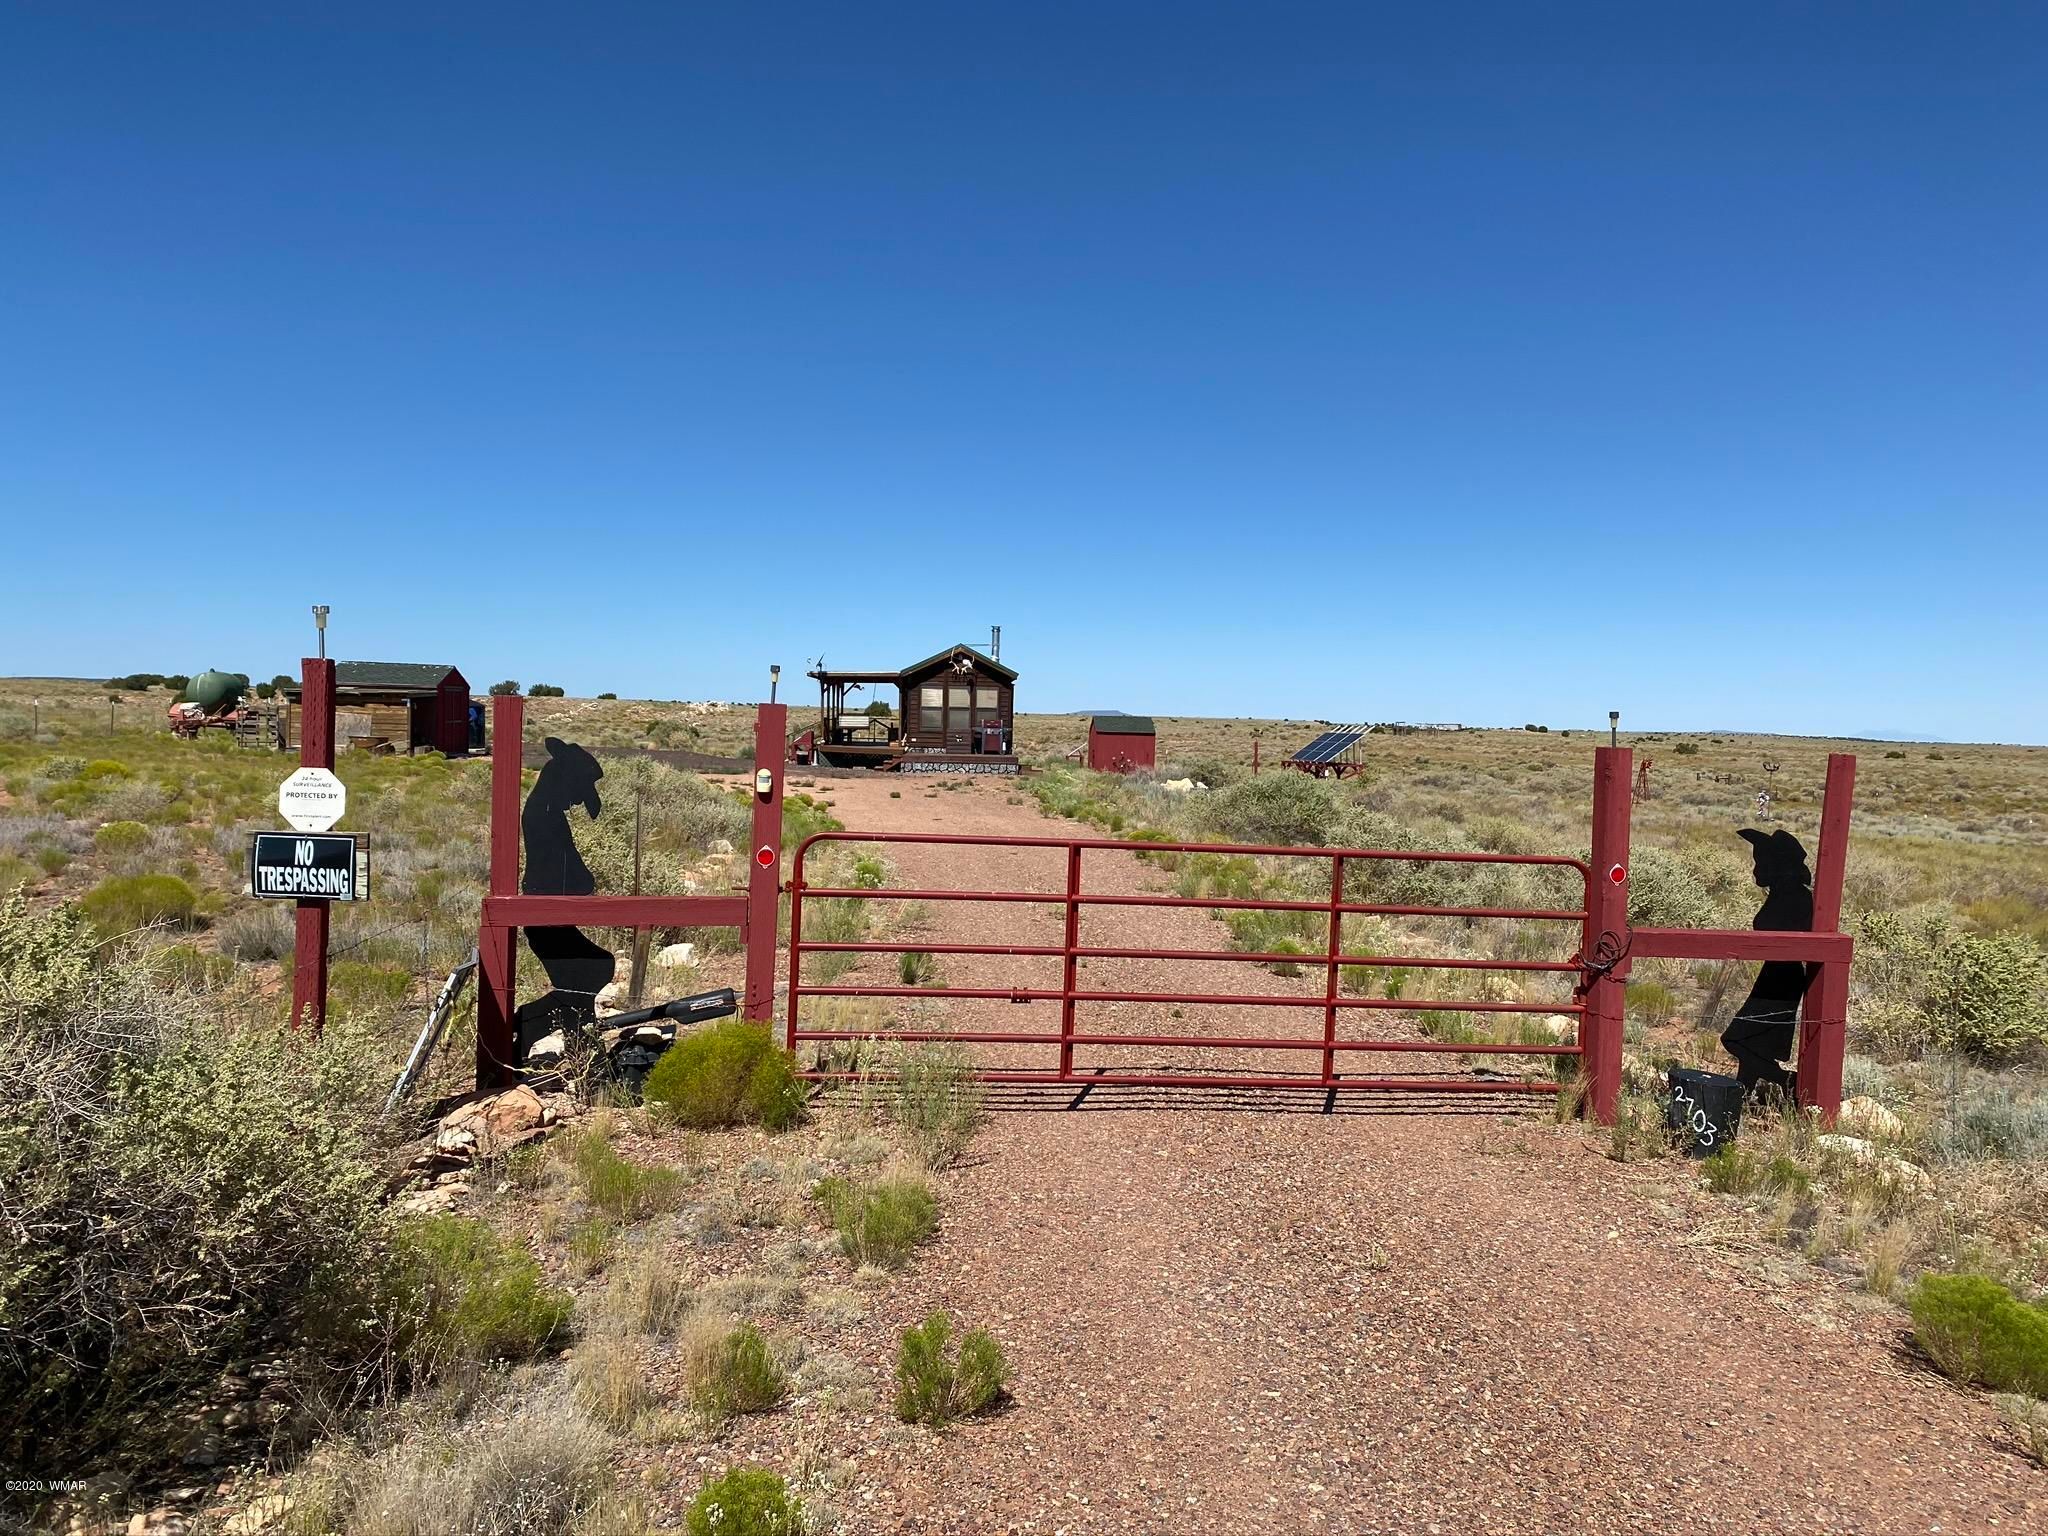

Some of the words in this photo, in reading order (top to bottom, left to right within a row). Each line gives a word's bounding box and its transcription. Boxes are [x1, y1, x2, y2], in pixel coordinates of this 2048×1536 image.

[294, 840, 314, 866] NO
[259, 866, 348, 893] TRESPASSING
[1675, 1086, 1717, 1146] 2703
